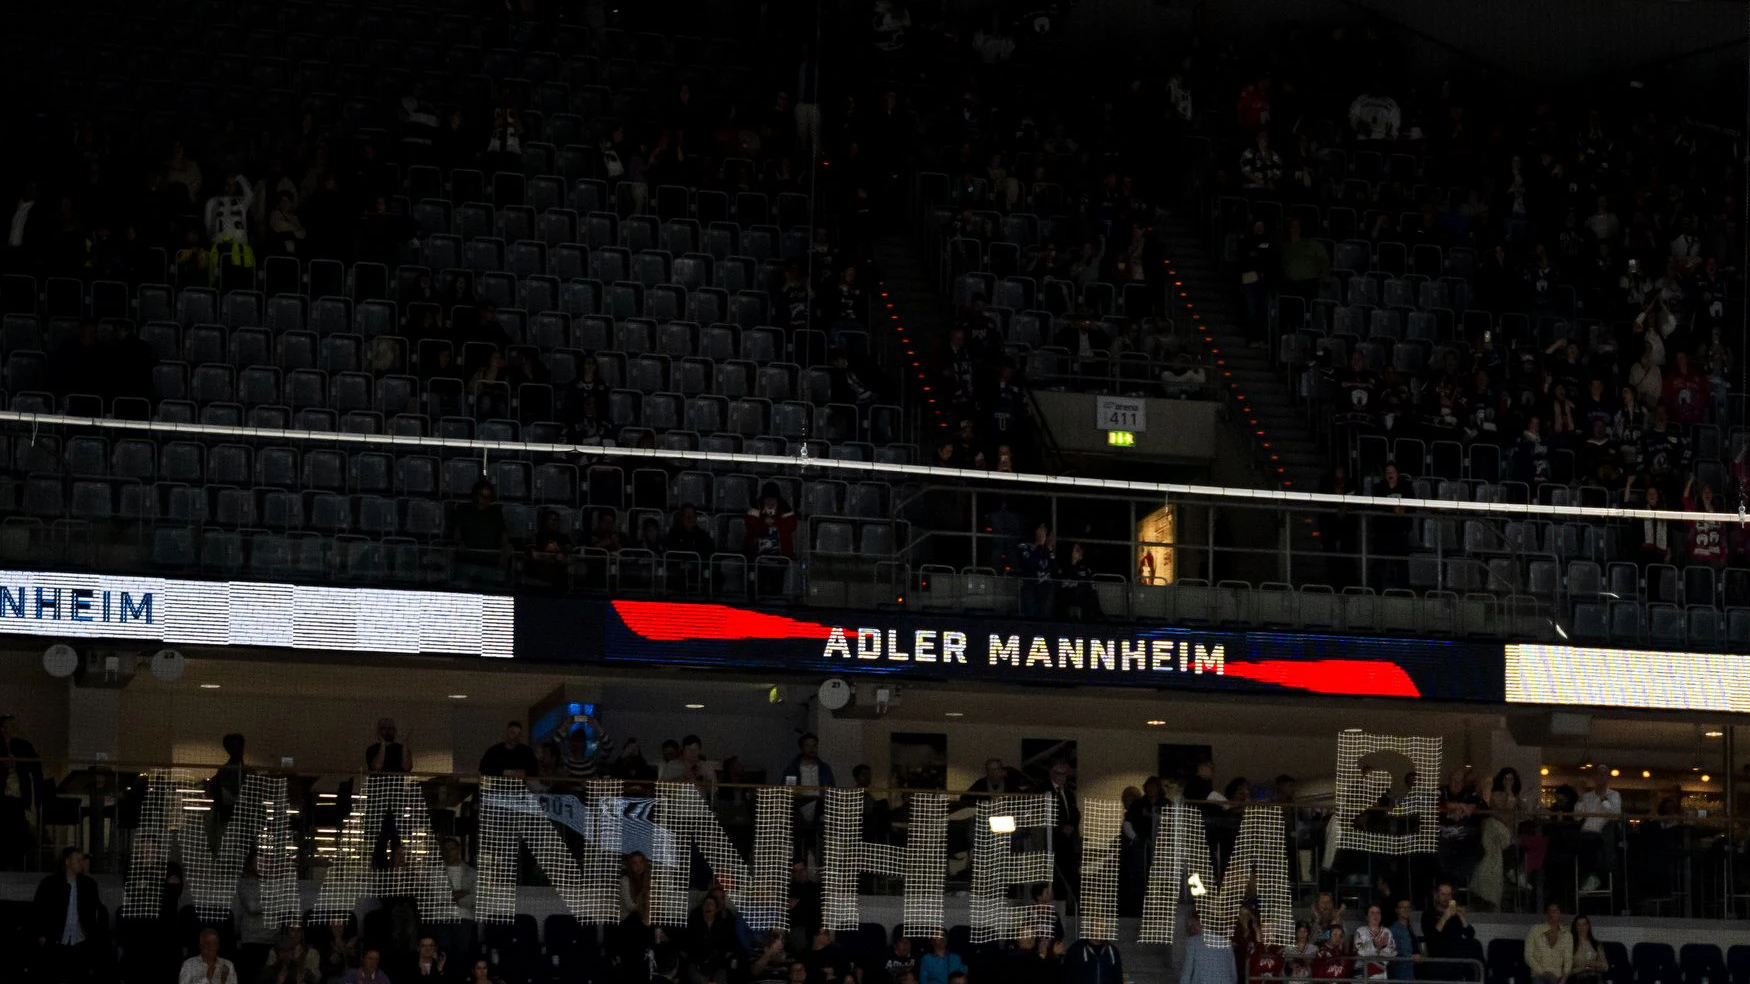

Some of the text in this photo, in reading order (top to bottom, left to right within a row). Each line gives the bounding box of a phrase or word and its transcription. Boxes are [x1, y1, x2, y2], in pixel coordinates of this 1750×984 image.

[1110, 412, 1136, 425] 411
[823, 627, 1226, 676] ADLER MANNHEIM
[122, 768, 1296, 948] MANNHEIM
